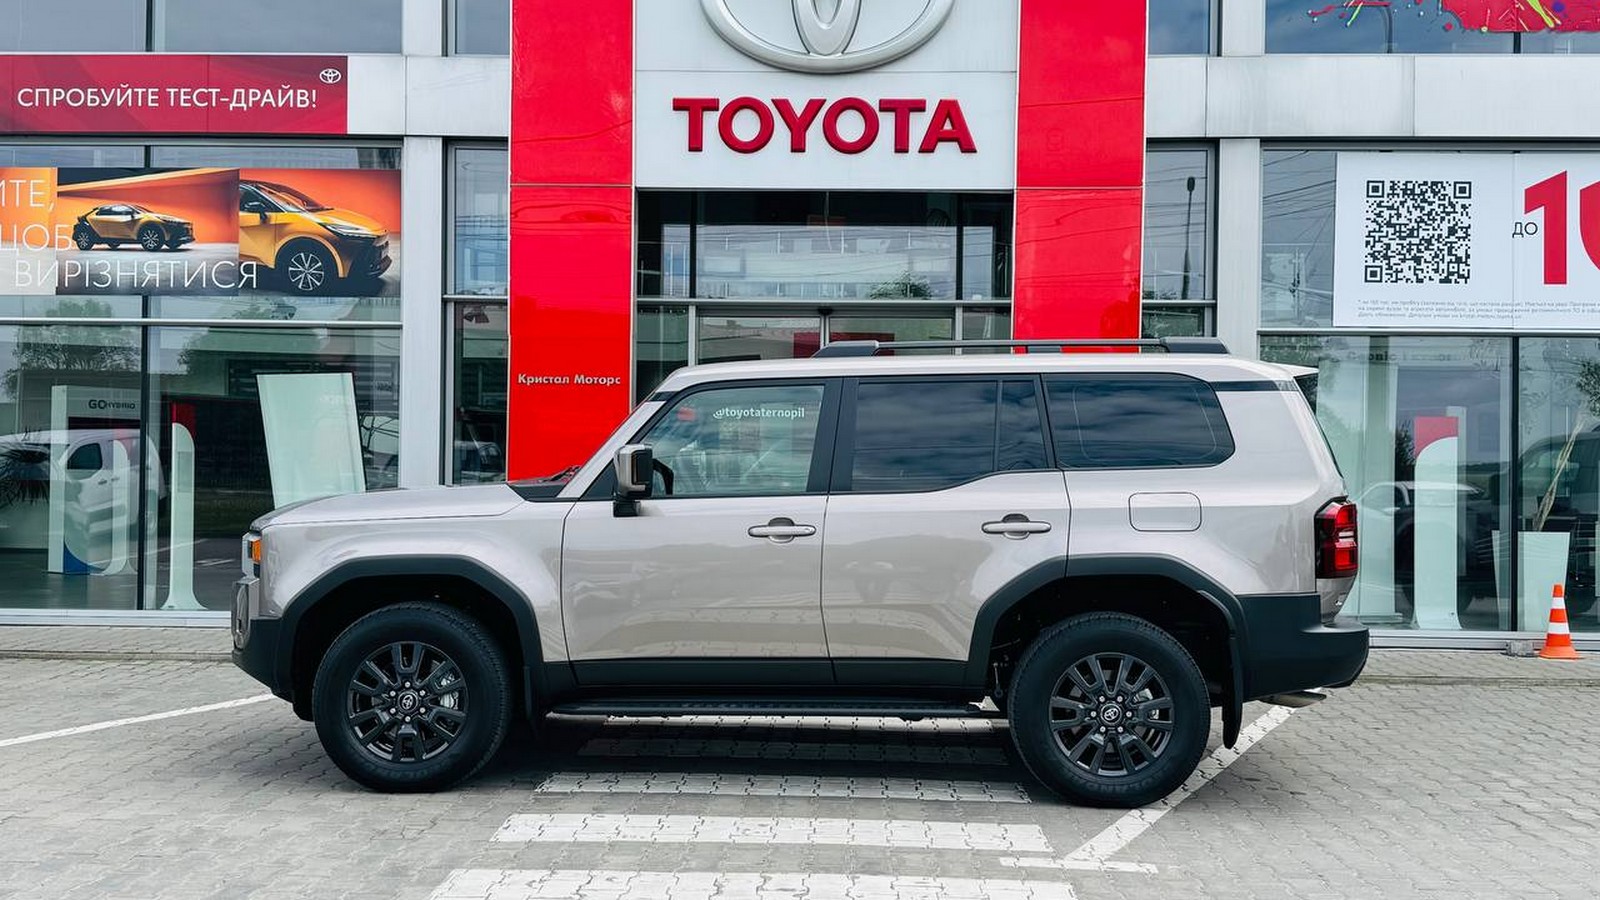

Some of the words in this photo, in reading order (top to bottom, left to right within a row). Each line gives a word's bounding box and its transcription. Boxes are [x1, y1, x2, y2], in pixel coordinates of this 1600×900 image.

[17, 85, 159, 108] СПРОБУЙТЕ
[166, 85, 317, 110] ТЕСТ-ДРАЙВ!
[672, 97, 977, 154] TOYOTA
[0, 179, 54, 212] ТЕ,
[15, 260, 257, 288] ВИРІЗНЯТИСЯ
[518, 374, 570, 385] Кристал
[574, 374, 621, 386] Моторс
[713, 407, 805, 420] @toyotaternopil
